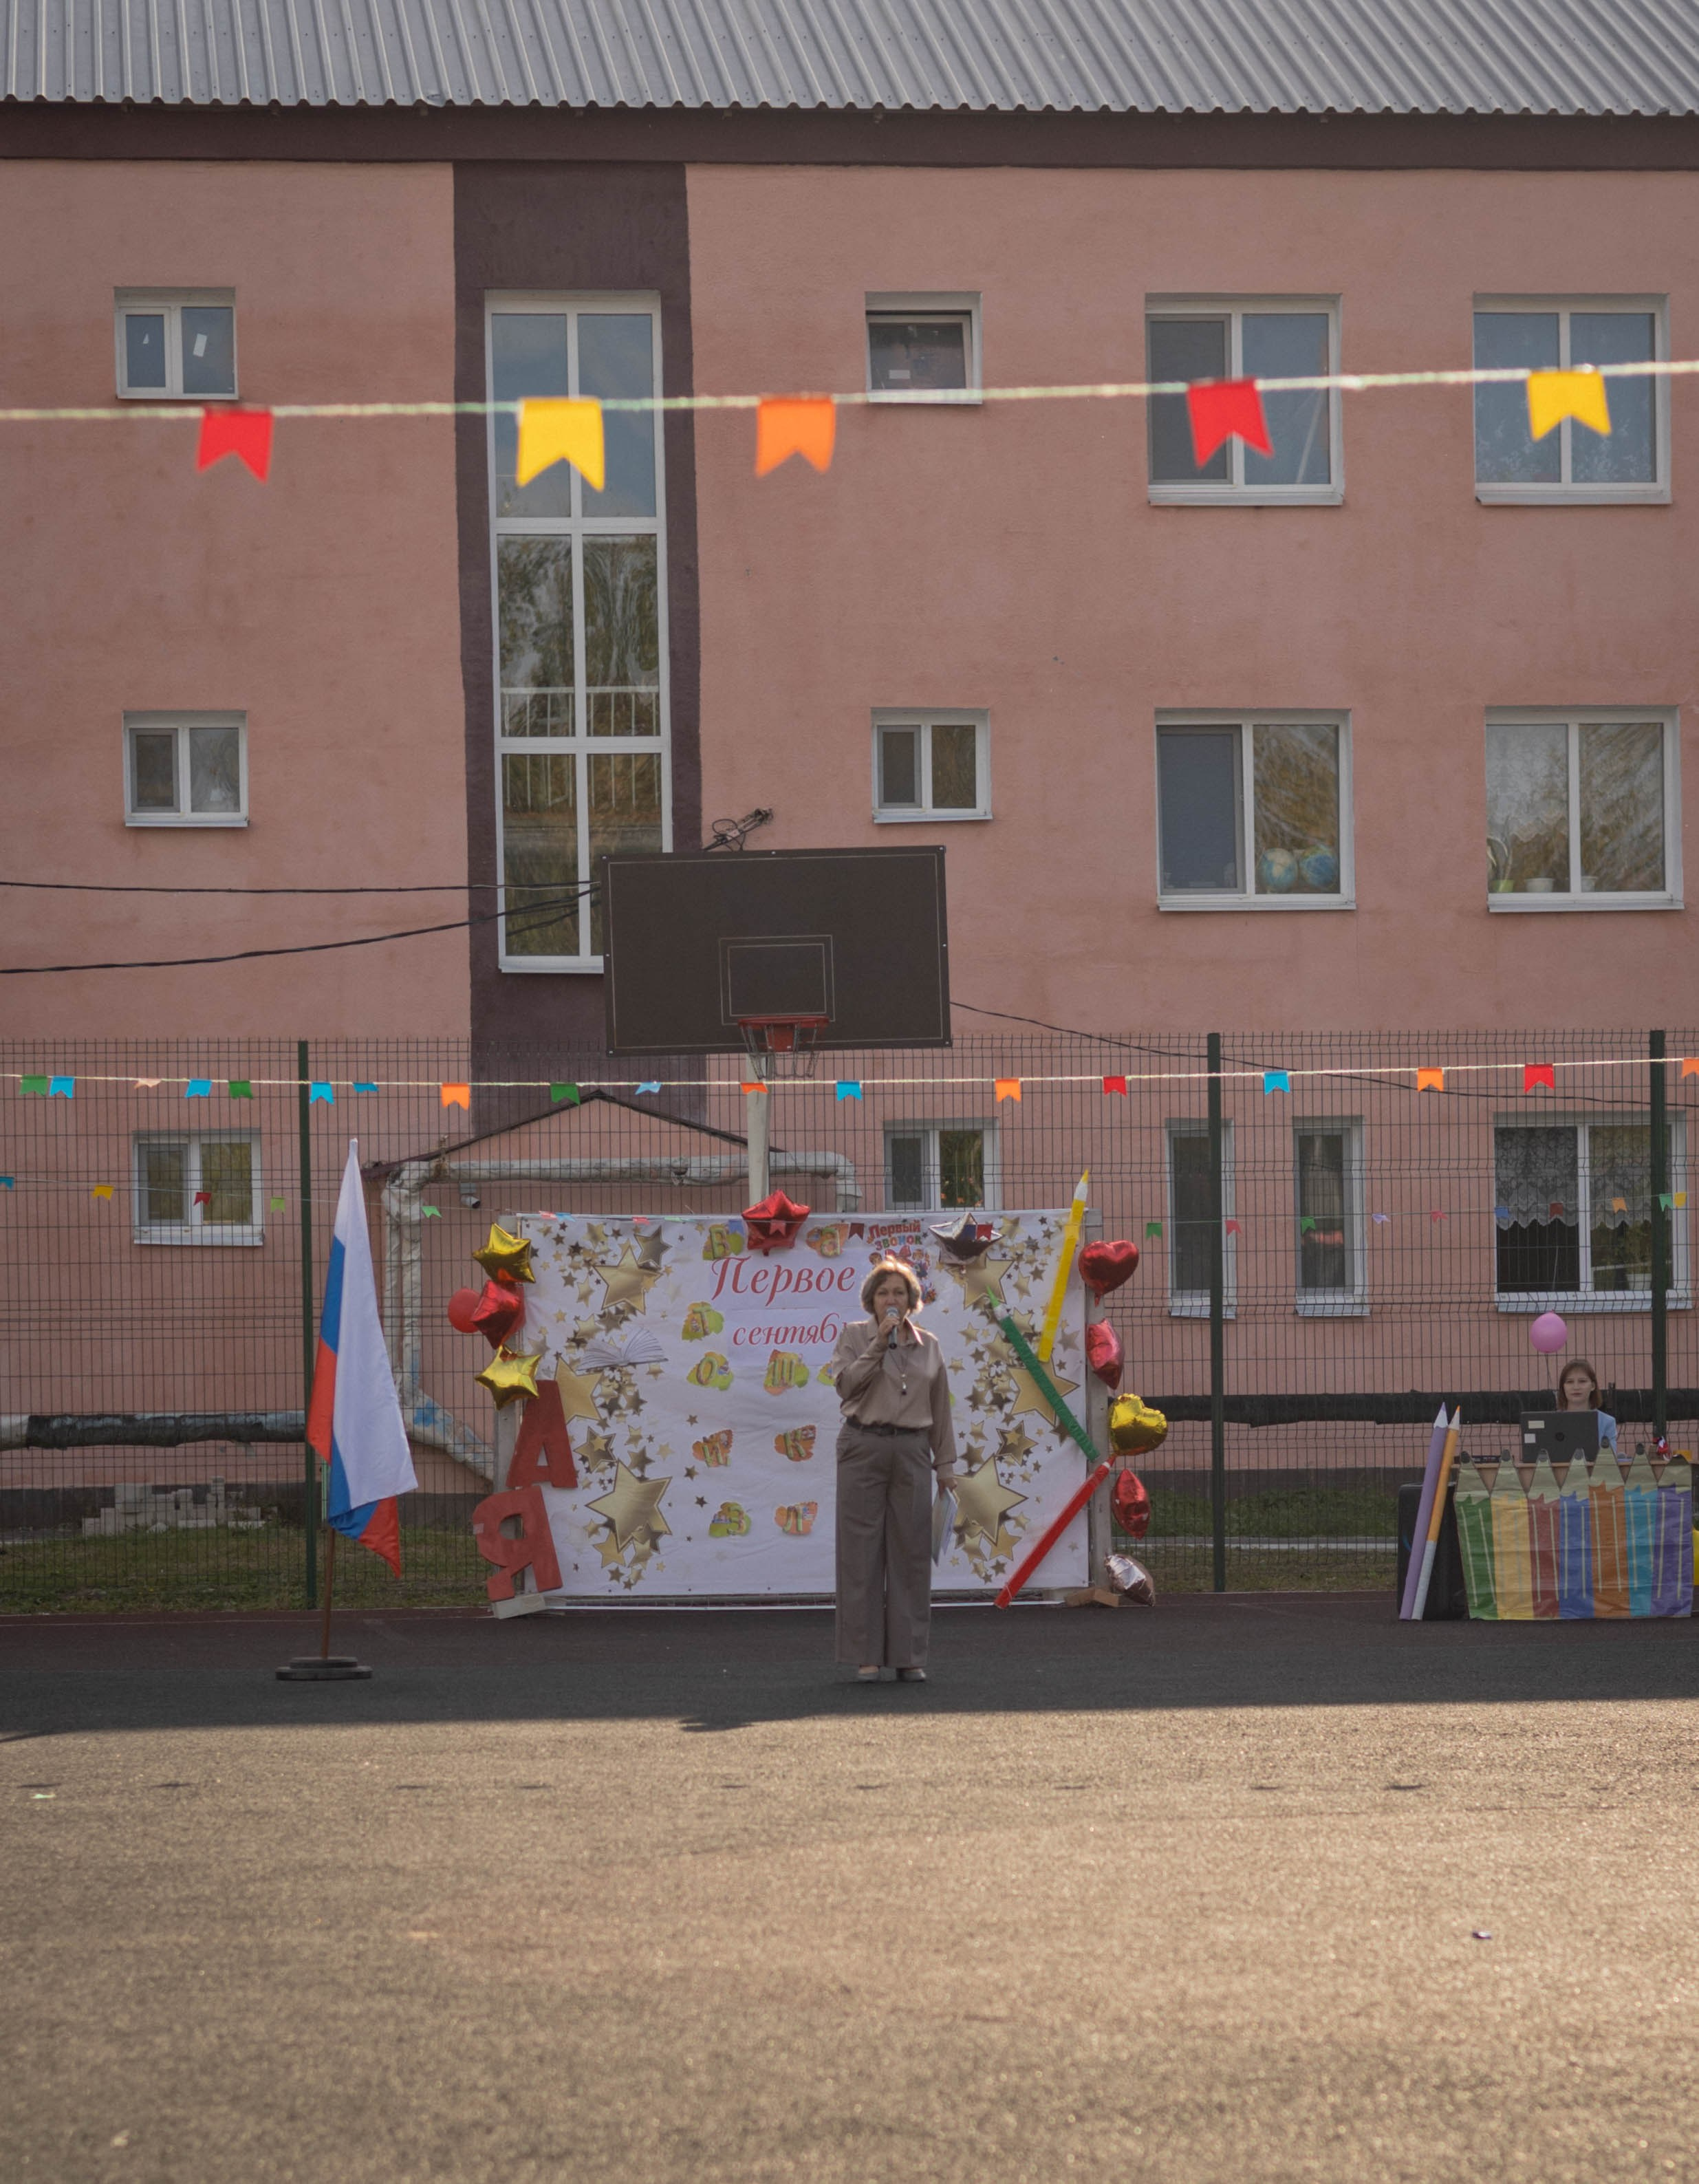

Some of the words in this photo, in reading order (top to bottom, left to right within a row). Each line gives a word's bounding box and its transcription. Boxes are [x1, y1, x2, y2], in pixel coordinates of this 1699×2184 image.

[867, 1220, 920, 1244] Первый
[711, 1255, 855, 1306] Первое
[733, 1312, 847, 1345] сентяб
[506, 1380, 578, 1489] А
[473, 1486, 563, 1601] Я
